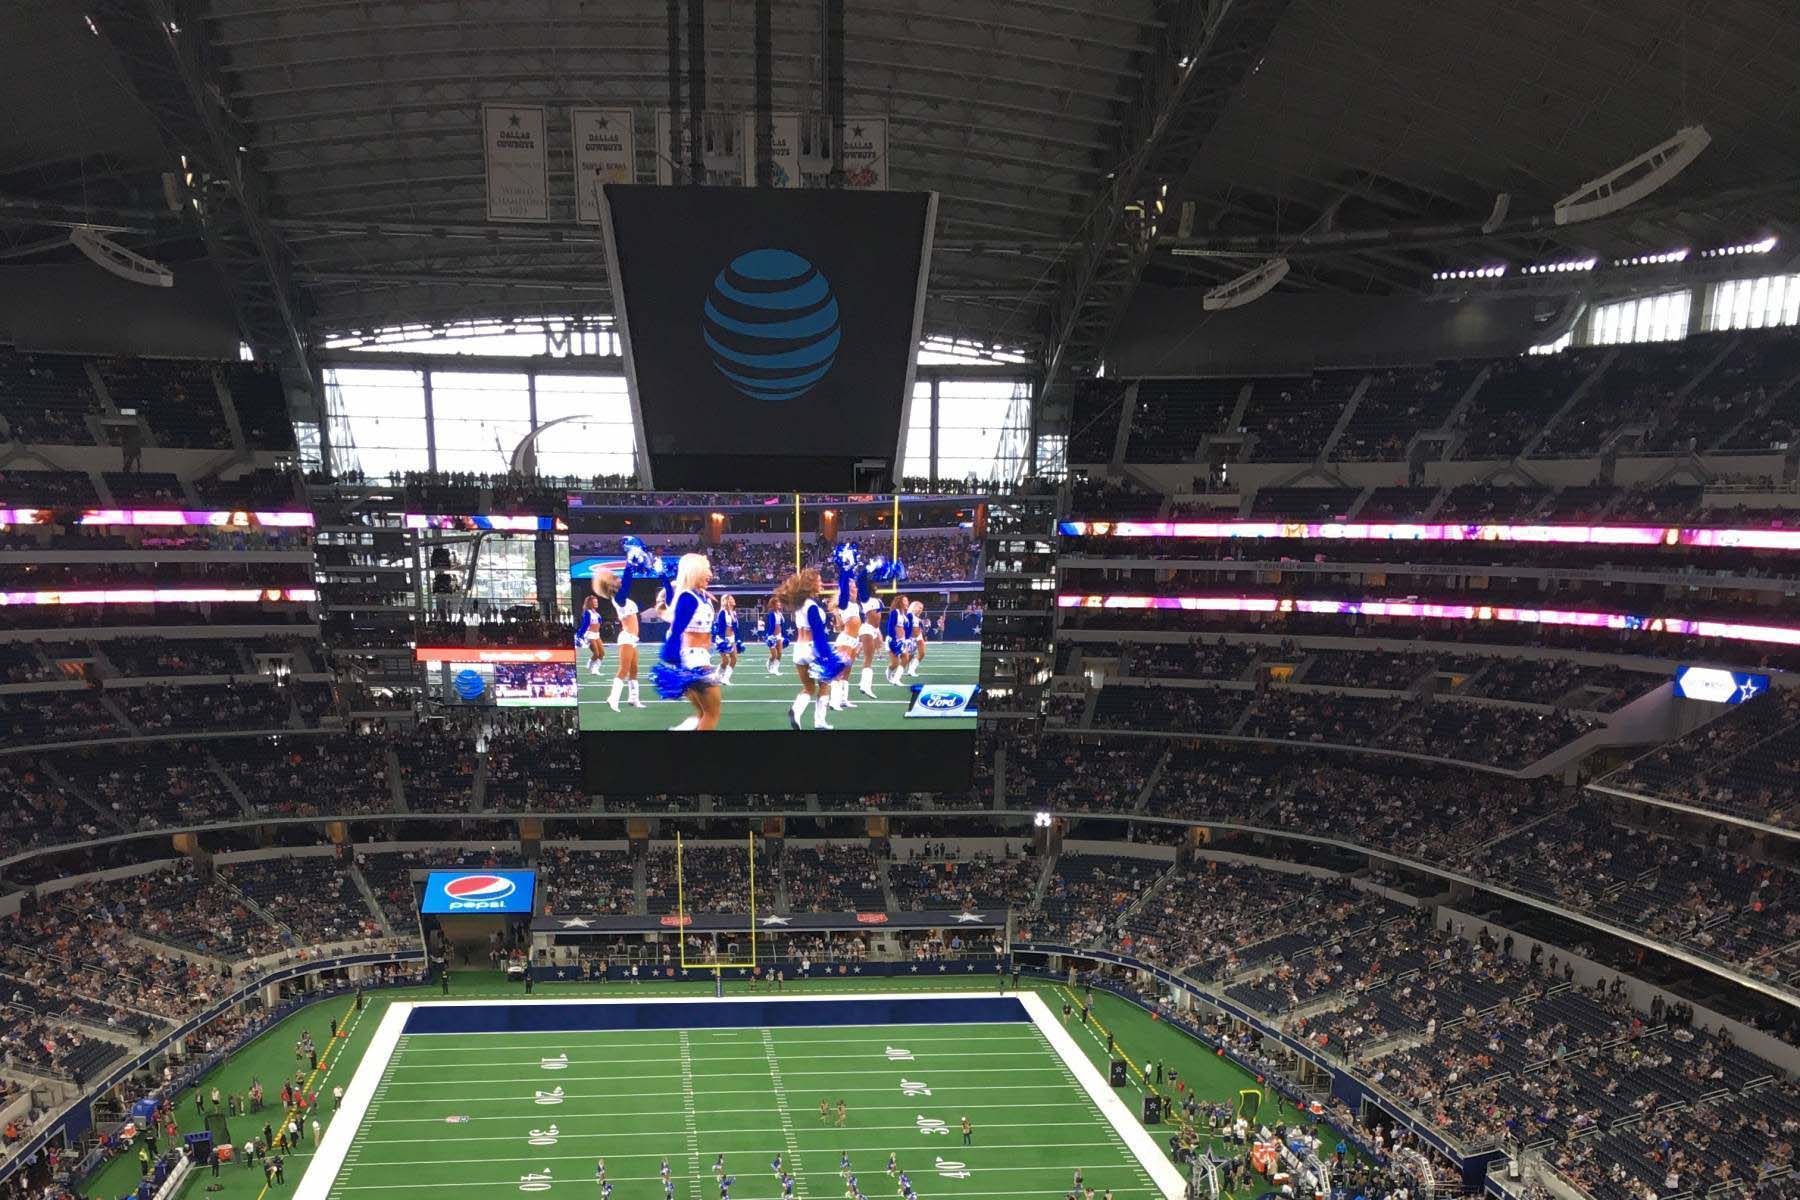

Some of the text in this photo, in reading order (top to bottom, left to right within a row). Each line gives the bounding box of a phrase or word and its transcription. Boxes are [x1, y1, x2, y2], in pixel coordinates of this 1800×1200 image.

[500, 130, 531, 140] DALLAS
[588, 134, 619, 142] DALLAS
[496, 140, 535, 149] COWBOYS
[585, 143, 623, 152] COWBOYS
[927, 693, 957, 707] Ford
[449, 900, 504, 910] pepsi
[885, 1047, 915, 1061] 10
[540, 1057, 568, 1069] 10
[900, 1081, 931, 1096] 20
[534, 1089, 565, 1104] 20
[917, 1118, 950, 1135] 30
[528, 1128, 560, 1145] 30
[935, 1160, 971, 1179] 40
[519, 1173, 553, 1191] 40
